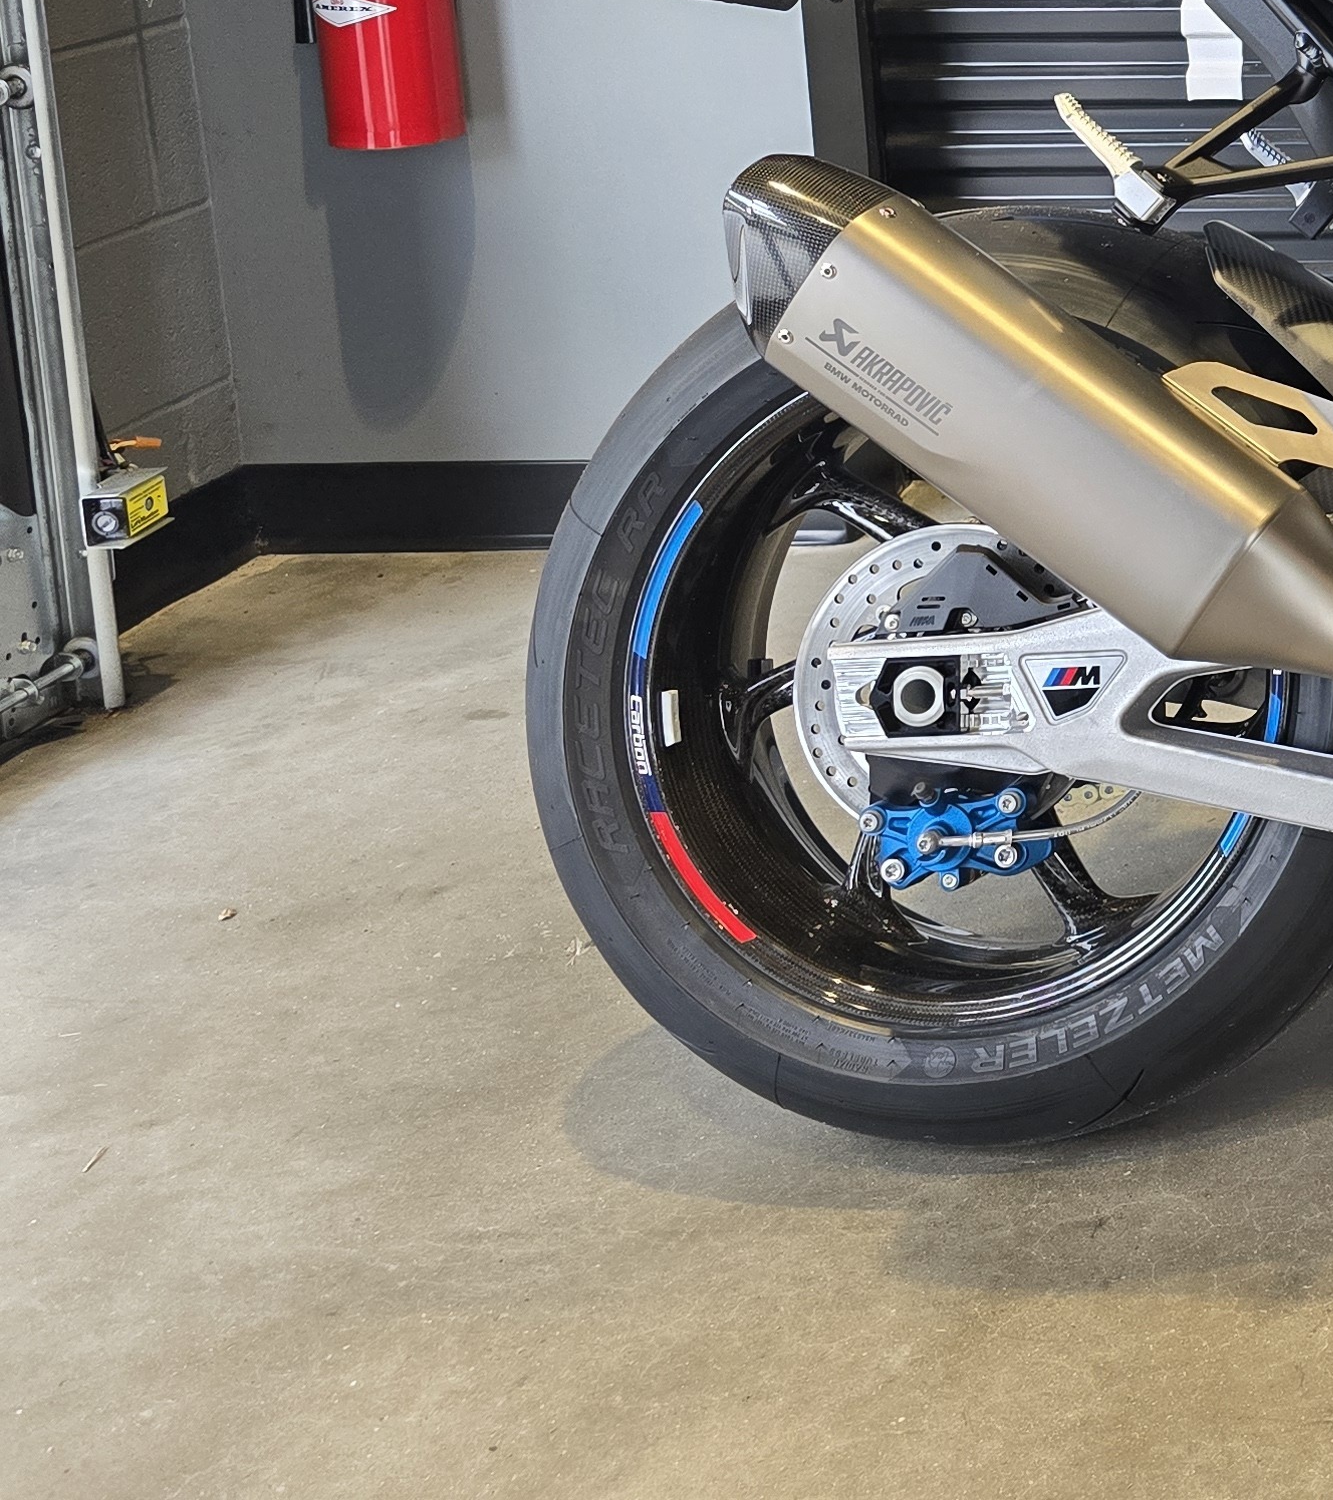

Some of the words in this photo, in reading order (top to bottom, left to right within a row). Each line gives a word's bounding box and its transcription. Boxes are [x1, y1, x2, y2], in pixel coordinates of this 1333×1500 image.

[315, 3, 373, 12] AMEREX
[824, 362, 852, 384] BMW
[851, 381, 909, 427] MOTORRAD
[970, 924, 1225, 1073] METZELER
